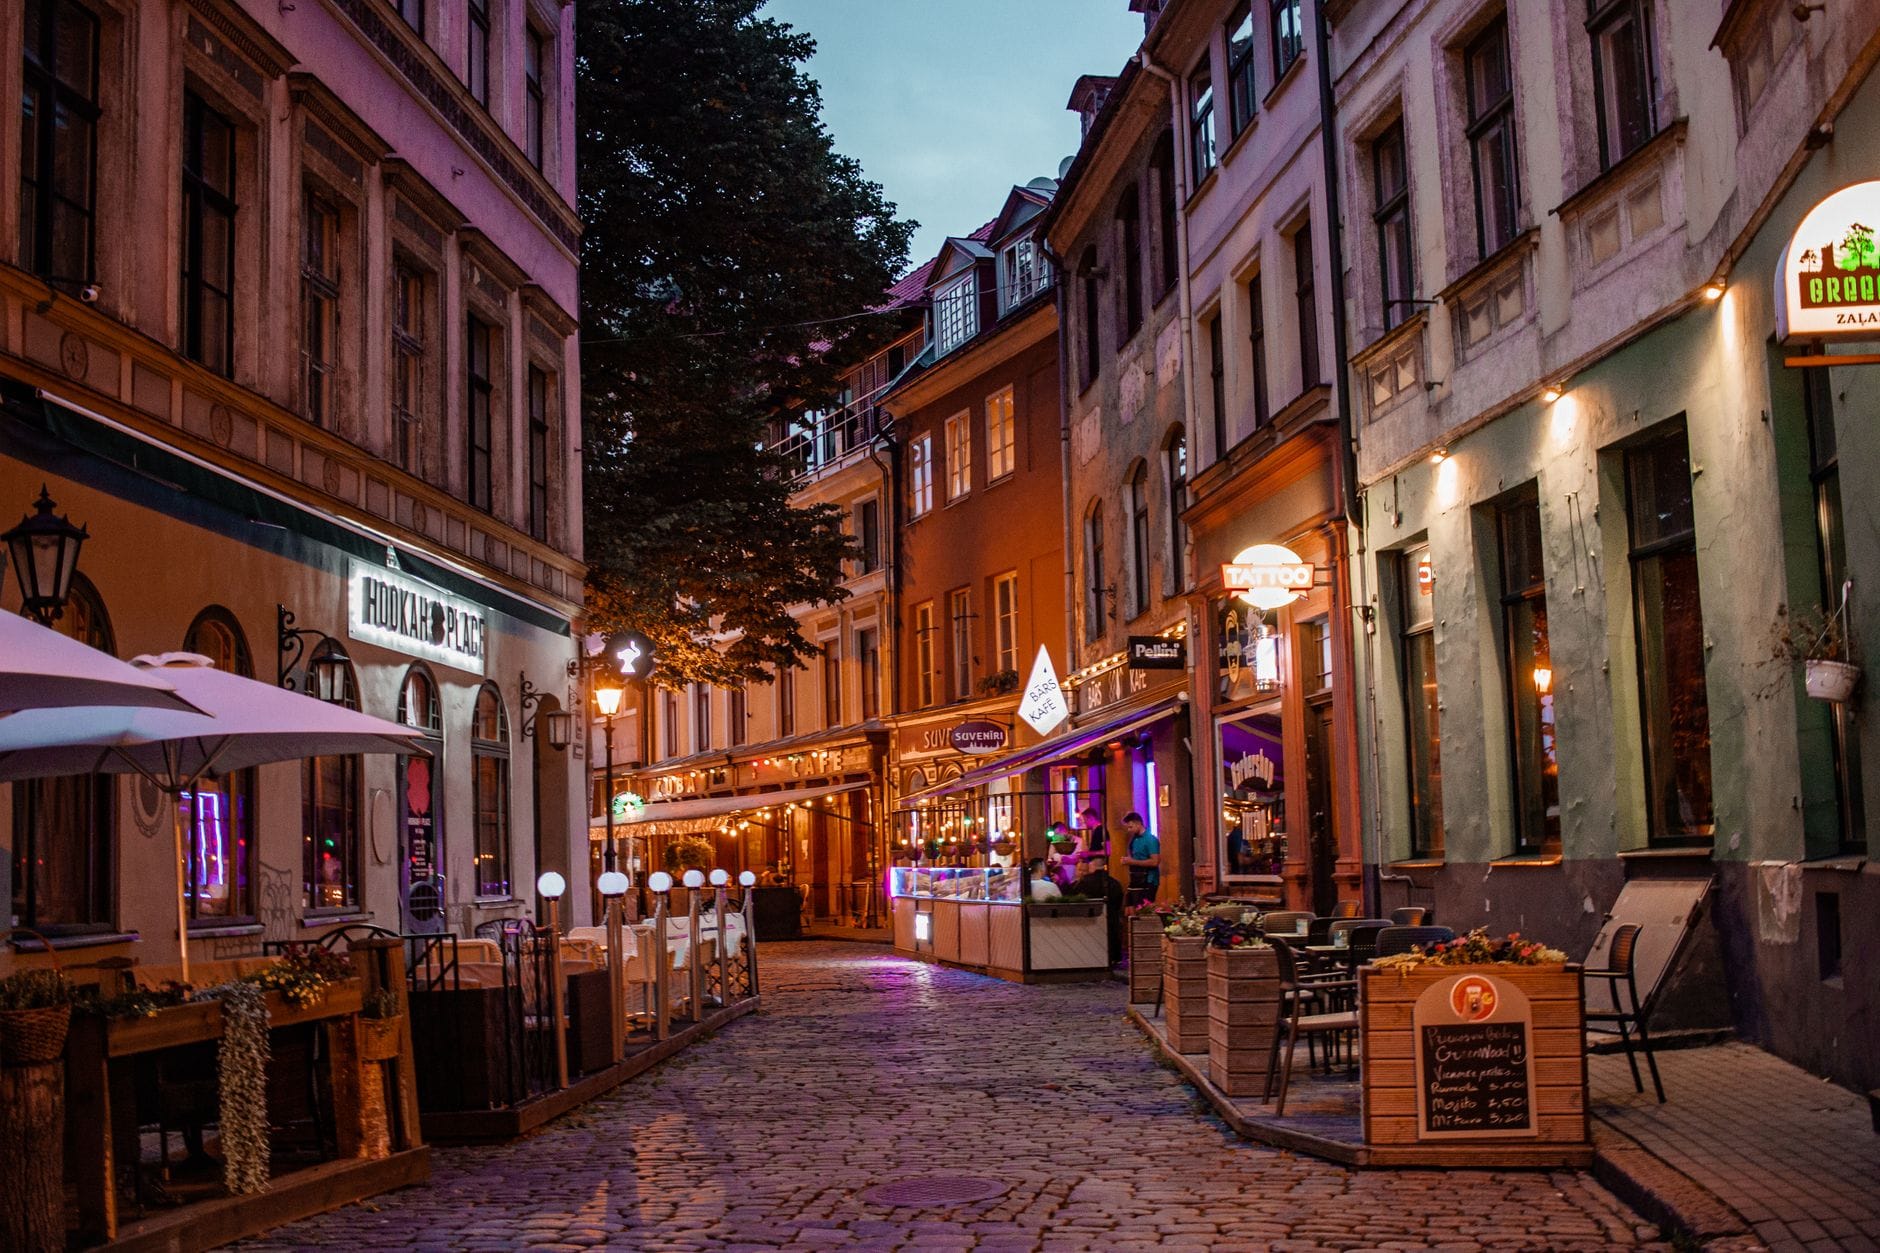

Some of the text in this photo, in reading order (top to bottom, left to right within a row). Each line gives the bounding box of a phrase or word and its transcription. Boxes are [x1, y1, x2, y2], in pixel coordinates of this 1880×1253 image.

[1809, 274, 1880, 303] GREE
[1836, 312, 1880, 326] ZAĻA
[1226, 566, 1310, 586] TATTOO
[362, 576, 485, 659] HOOKAH PLACE
[1135, 642, 1180, 658] Pellini
[1029, 678, 1057, 702] BĀRS
[955, 730, 1004, 741] SUVENĪRI
[655, 751, 842, 795] CUBA CAFE
